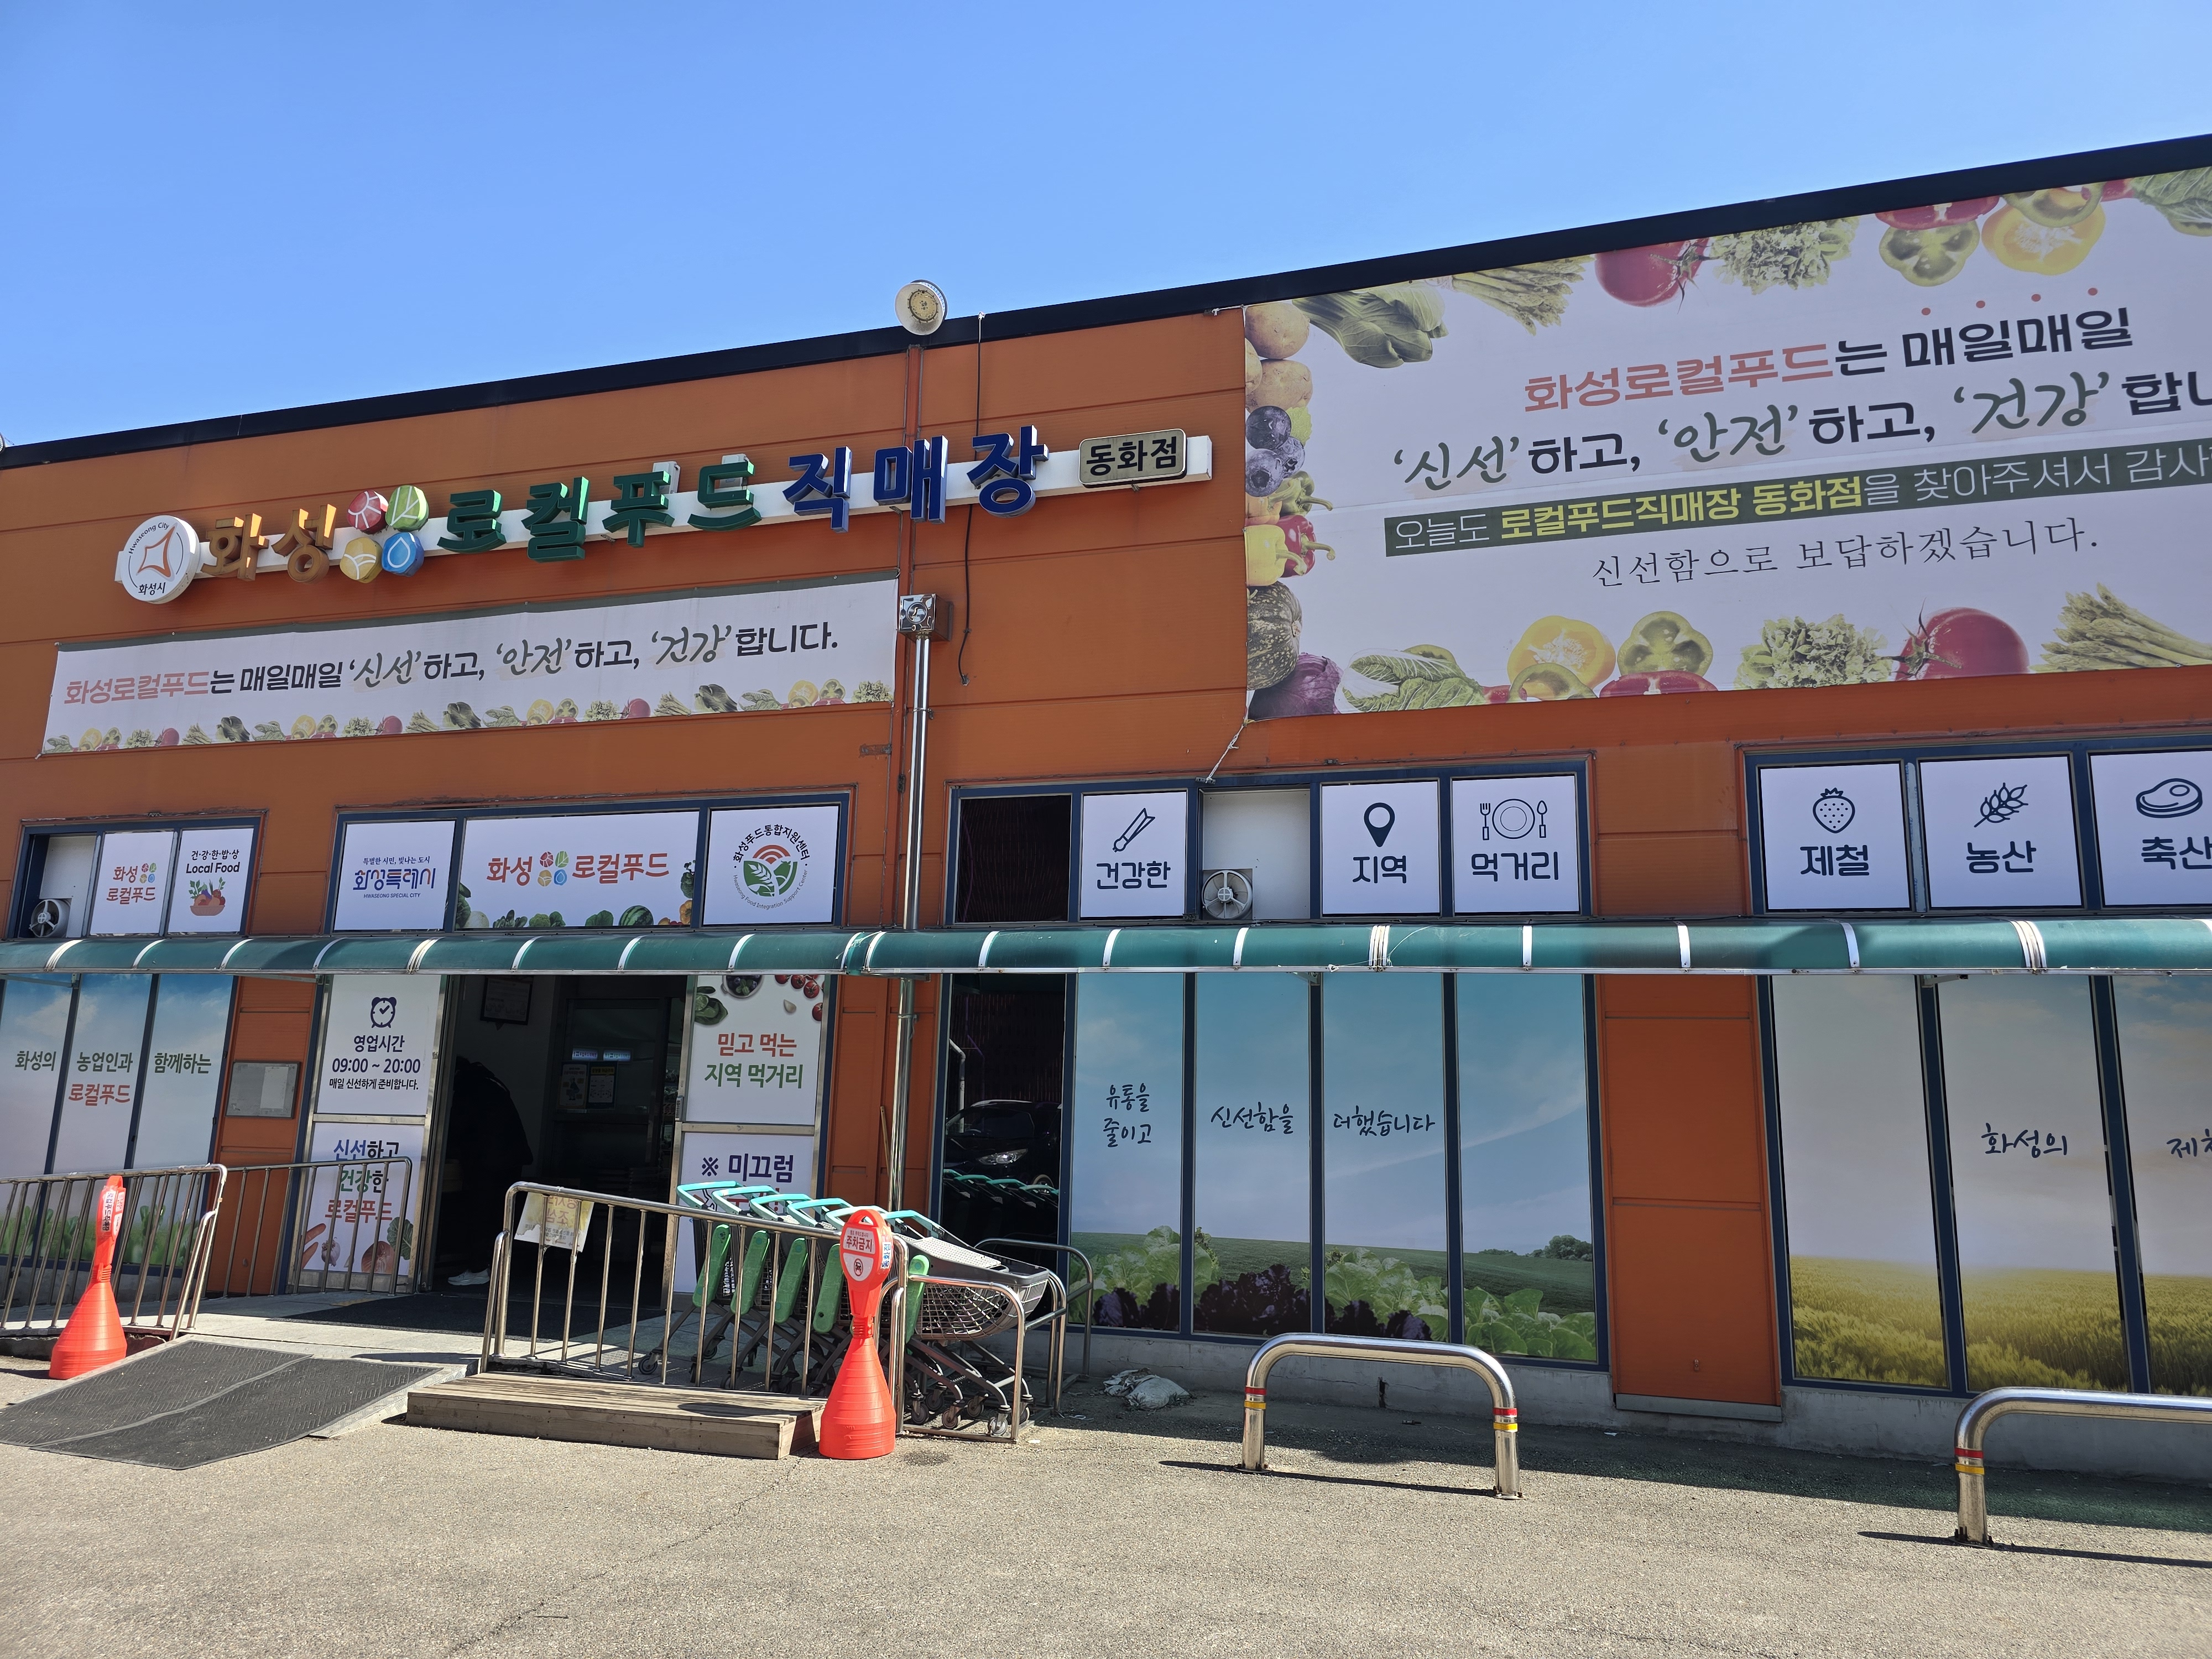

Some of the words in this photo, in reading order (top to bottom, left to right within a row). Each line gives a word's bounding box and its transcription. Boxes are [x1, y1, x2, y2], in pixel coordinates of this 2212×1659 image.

[1525, 340, 1887, 413] 화성로컬푸드는
[1902, 307, 2133, 367] 매일매일
[200, 503, 337, 584] 화성
[437, 458, 761, 563] 로컬푸드
[782, 425, 1049, 533] 직매장
[1086, 436, 1178, 477] 동화점
[1395, 513, 1489, 551] 오늘도
[1501, 488, 1741, 540] 로컬푸드직매장
[1752, 473, 1900, 515] 동화점을
[1914, 453, 2112, 501] 찾아주셔서
[2126, 444, 2212, 483] 감사
[128, 525, 156, 554] Hwaseong
[158, 522, 170, 530] City
[1593, 546, 1778, 588] 신선함으로
[1797, 517, 2098, 570] 보답하겠습니다.
[138, 582, 166, 596] 화성시
[64, 669, 235, 705] 화성로컬푸드는
[239, 662, 343, 692] 매일매일
[733, 824, 810, 863] 화성푸드통합지원센터
[1800, 844, 1870, 877] 제철
[1966, 840, 2037, 874] 농산
[2141, 836, 2212, 870] 축산
[186, 862, 213, 874] Local
[215, 862, 241, 873] Food
[363, 857, 382, 865] 특별한
[382, 857, 397, 865] 시민,
[398, 856, 417, 865] 빛나는
[418, 855, 431, 864] 도시
[486, 855, 533, 886] 화성
[572, 852, 670, 885] 로컬푸드
[1096, 860, 1171, 890] 건강한
[1352, 854, 1408, 884] 지역
[1471, 851, 1559, 881] 먹거리
[112, 865, 138, 884] 화성
[352, 868, 436, 891] 화성특례시
[106, 886, 156, 905] 로컬푸드
[733, 874, 745, 900] Hwaseong
[744, 896, 757, 907] Food
[757, 901, 784, 910] Integration
[783, 886, 801, 904] Support
[799, 869, 808, 887] Center
[353, 1035, 405, 1053] 영업시간
[717, 1032, 755, 1057] 믿고
[759, 1033, 797, 1057] 먹는
[14, 1050, 56, 1072] 화성의
[76, 1051, 133, 1073] 농업인과
[154, 1052, 212, 1074] 함께하는
[332, 1058, 368, 1073] 09:00
[383, 1058, 421, 1073] 20:00
[329, 1078, 345, 1089] 매일
[346, 1078, 377, 1090] 신선하게
[378, 1079, 419, 1091] 준비합니다.
[704, 1063, 742, 1088] 지역
[748, 1063, 804, 1089] 먹거리
[68, 1083, 131, 1107] 로컬푸드
[1106, 1082, 1150, 1113] 유통을
[1103, 1117, 1152, 1147] 줄이고
[1210, 1102, 1294, 1135] 신선함을
[1333, 1105, 1436, 1138] 더했습니다
[333, 1139, 399, 1161] 신선하고
[1981, 1122, 2068, 1158] 화성의
[728, 1153, 794, 1183] 미끄럼
[325, 1199, 393, 1223] 로컬푸드
[846, 1235, 873, 1252] 주차금지
